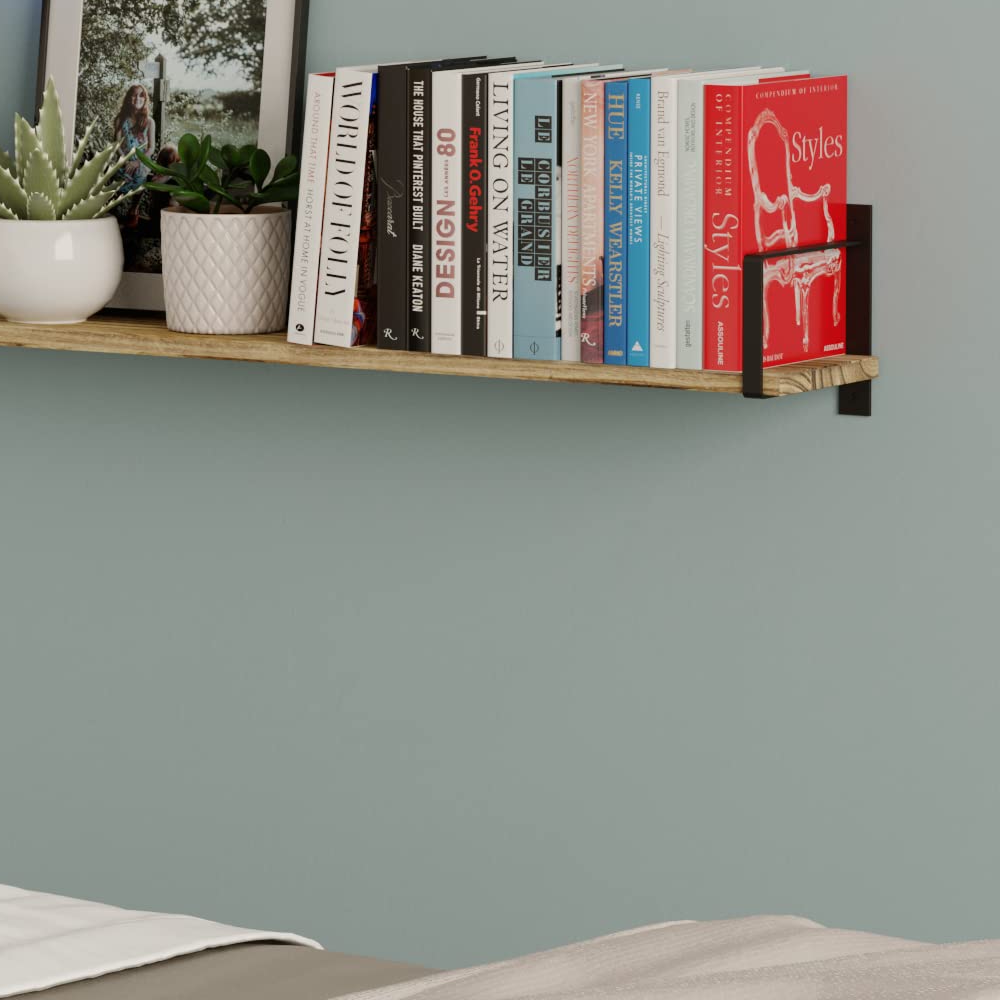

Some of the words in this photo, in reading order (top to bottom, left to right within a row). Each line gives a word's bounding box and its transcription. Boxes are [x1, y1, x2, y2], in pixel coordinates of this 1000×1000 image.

[412, 80, 424, 97] THE
[715, 93, 723, 112] OF
[756, 88, 796, 100] COMPENDIUM
[809, 84, 838, 94] INTERIOR
[311, 92, 321, 134] AROUND
[412, 99, 424, 128] HOUSE
[492, 82, 509, 169] LIVING
[583, 92, 598, 128] NEW
[608, 92, 625, 140] HUE
[657, 91, 670, 124] Brand
[335, 82, 363, 175] WORLD
[412, 130, 424, 152] THAT
[436, 128, 456, 158] 80
[469, 127, 483, 166] Frank
[535, 116, 552, 143] LE
[657, 128, 665, 147] van
[724, 93, 732, 197] COMPENDIUM
[309, 137, 318, 160] THAT
[583, 135, 597, 177] YORK
[791, 126, 843, 171] Styles
[306, 162, 316, 184] TIME
[412, 154, 424, 204] PINTEREST
[518, 157, 534, 184] LE
[609, 160, 623, 216] KELLY
[634, 154, 642, 201] PRIVATE
[654, 151, 670, 197] Egmond
[304, 188, 314, 220] HORST
[332, 181, 353, 216] OF
[492, 178, 509, 212] ON
[303, 223, 311, 232] AT
[412, 206, 424, 232] BUILT
[518, 198, 534, 266] GRAND
[535, 158, 552, 281] CORBUSIER
[582, 183, 597, 287] APARTMENTS
[634, 206, 642, 244] VIEWS
[301, 235, 310, 264] HOME
[324, 222, 351, 296] FOLLY
[412, 244, 424, 272] DIANE
[436, 200, 456, 299] DESIGN
[492, 220, 509, 303] WATER
[653, 233, 670, 277] Lighting
[704, 212, 742, 308] Styles
[300, 266, 308, 276] IN
[609, 221, 623, 328] WEARSTLER
[297, 279, 307, 312] VOGUE
[412, 275, 424, 312] KEATON
[653, 278, 670, 332] Sculptures
